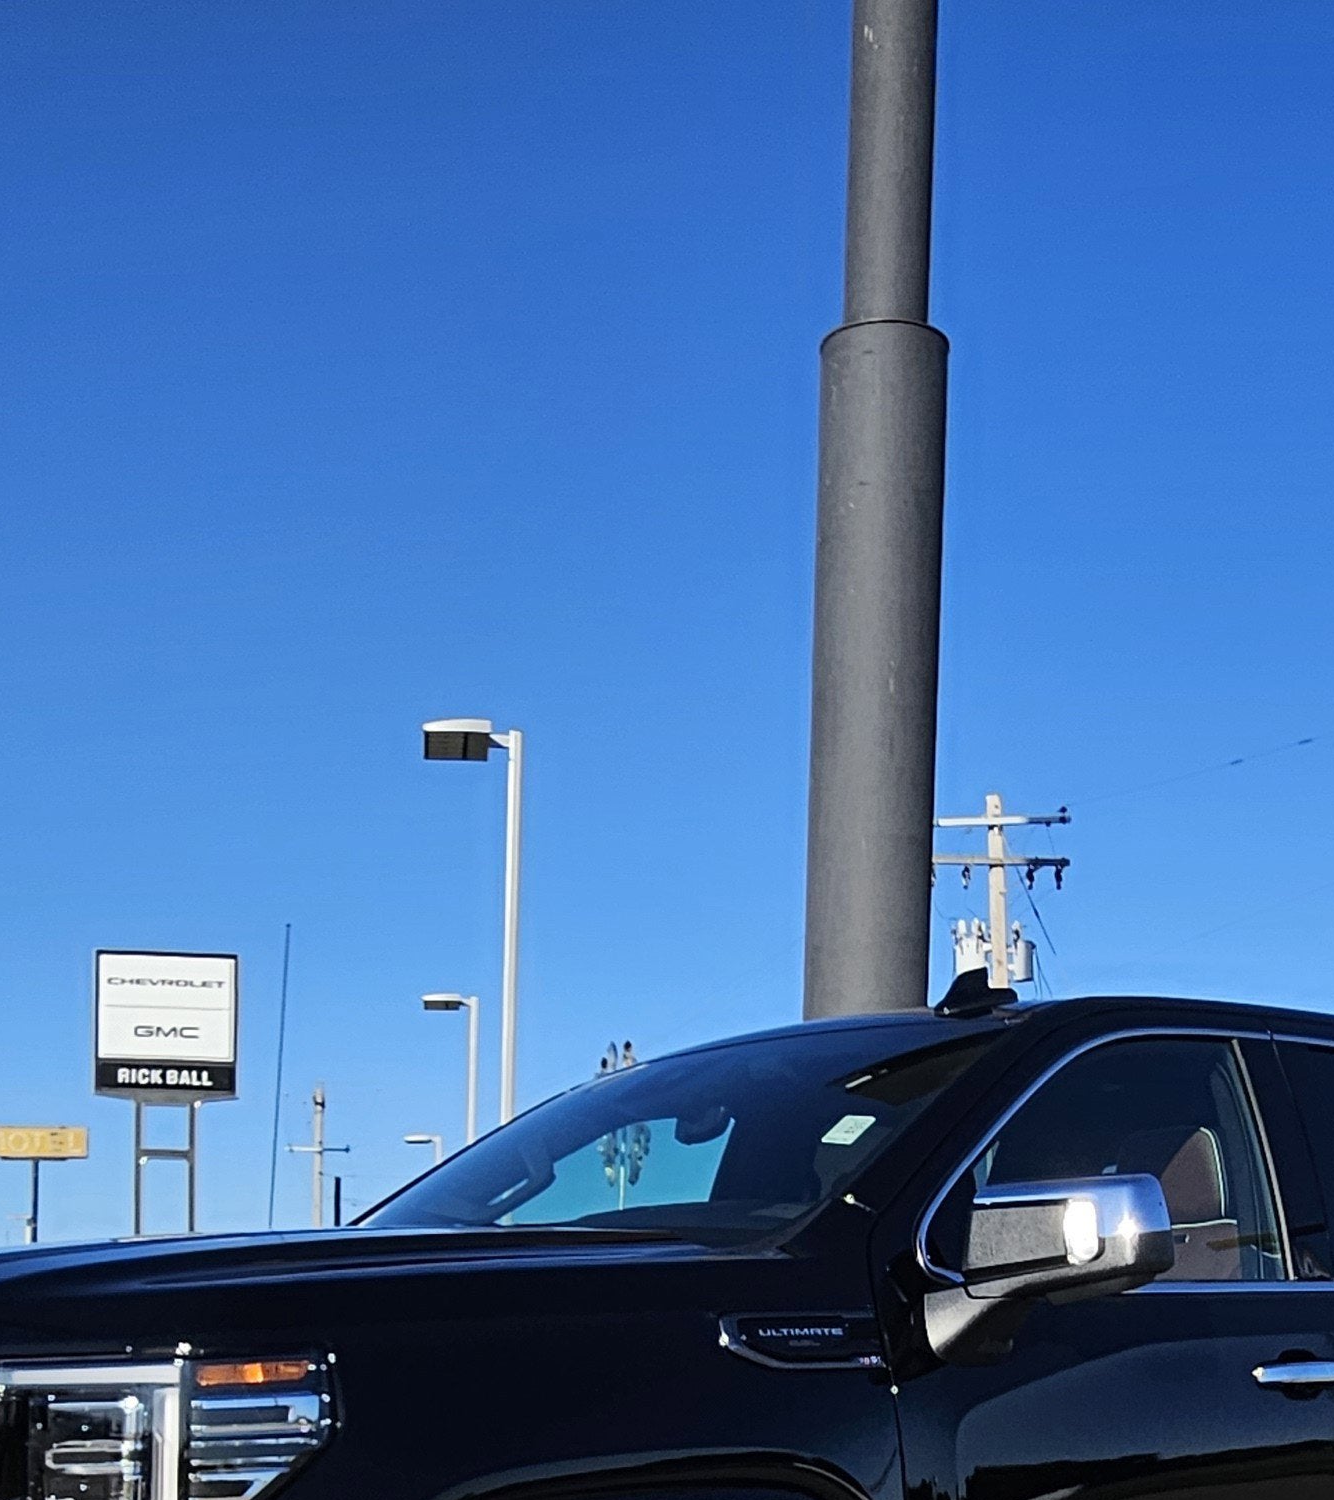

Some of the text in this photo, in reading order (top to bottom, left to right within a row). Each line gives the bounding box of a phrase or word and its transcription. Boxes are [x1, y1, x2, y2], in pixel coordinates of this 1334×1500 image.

[107, 977, 225, 988] CHEVROLET
[134, 1025, 200, 1039] GMC
[117, 1067, 214, 1086] RICK BALL
[758, 1328, 844, 1337] ULTIMATE
